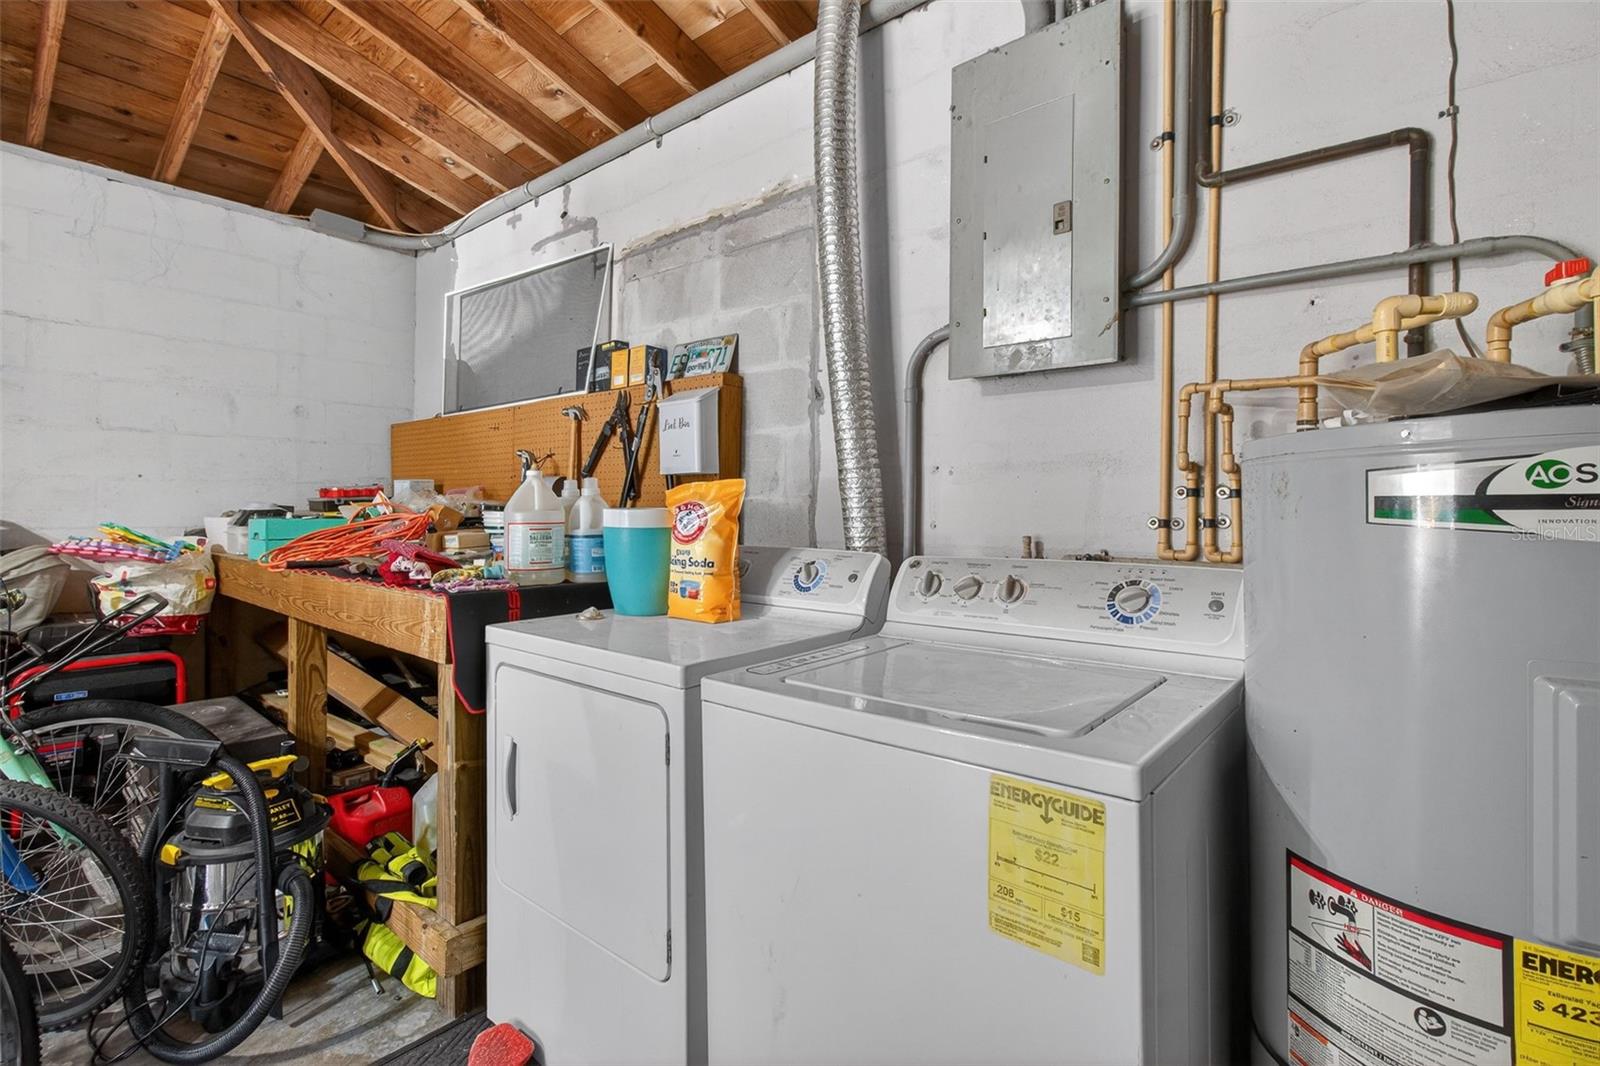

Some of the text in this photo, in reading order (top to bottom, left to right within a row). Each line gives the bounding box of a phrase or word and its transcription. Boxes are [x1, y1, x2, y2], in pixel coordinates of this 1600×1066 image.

[688, 556, 715, 569] Soda
[990, 781, 1105, 826] ENERGYGUIDE
[1034, 848, 1060, 873] $22
[1361, 893, 1404, 918] DANGER
